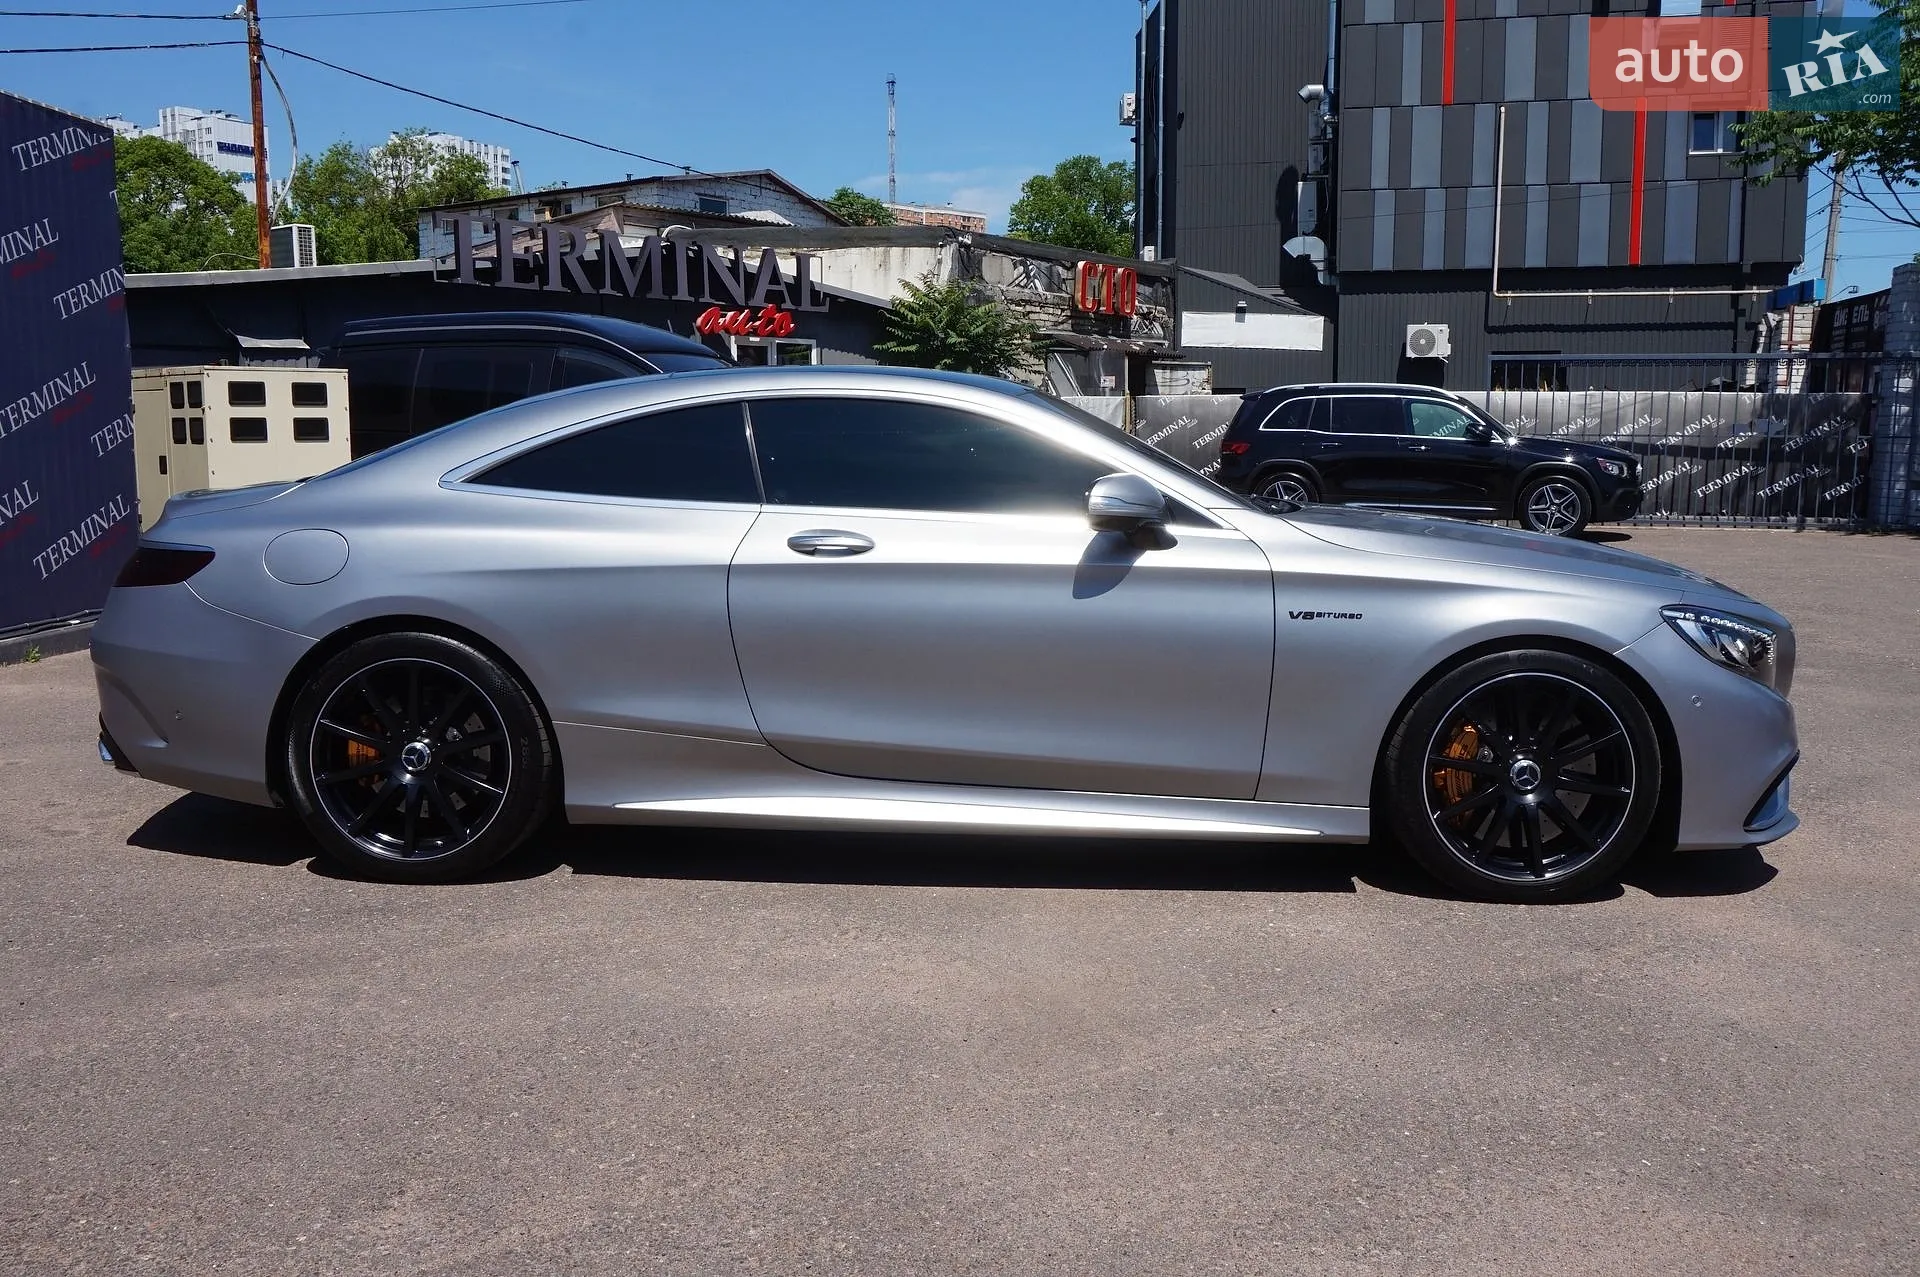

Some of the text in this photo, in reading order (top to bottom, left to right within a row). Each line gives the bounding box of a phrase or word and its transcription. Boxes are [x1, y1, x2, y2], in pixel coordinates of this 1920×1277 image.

[0, 218, 59, 264] MINAL
[432, 210, 830, 313] TERMINAL
[53, 264, 125, 320] TERMIN
[1077, 260, 1137, 316] СТО
[696, 304, 796, 337] auto
[90, 413, 134, 457] TERM
[1192, 421, 1230, 450] TERMIN
[1431, 415, 1471, 437] MINAL
[1640, 461, 1692, 493] ERMINAL
[32, 493, 130, 581] TERMINAL
